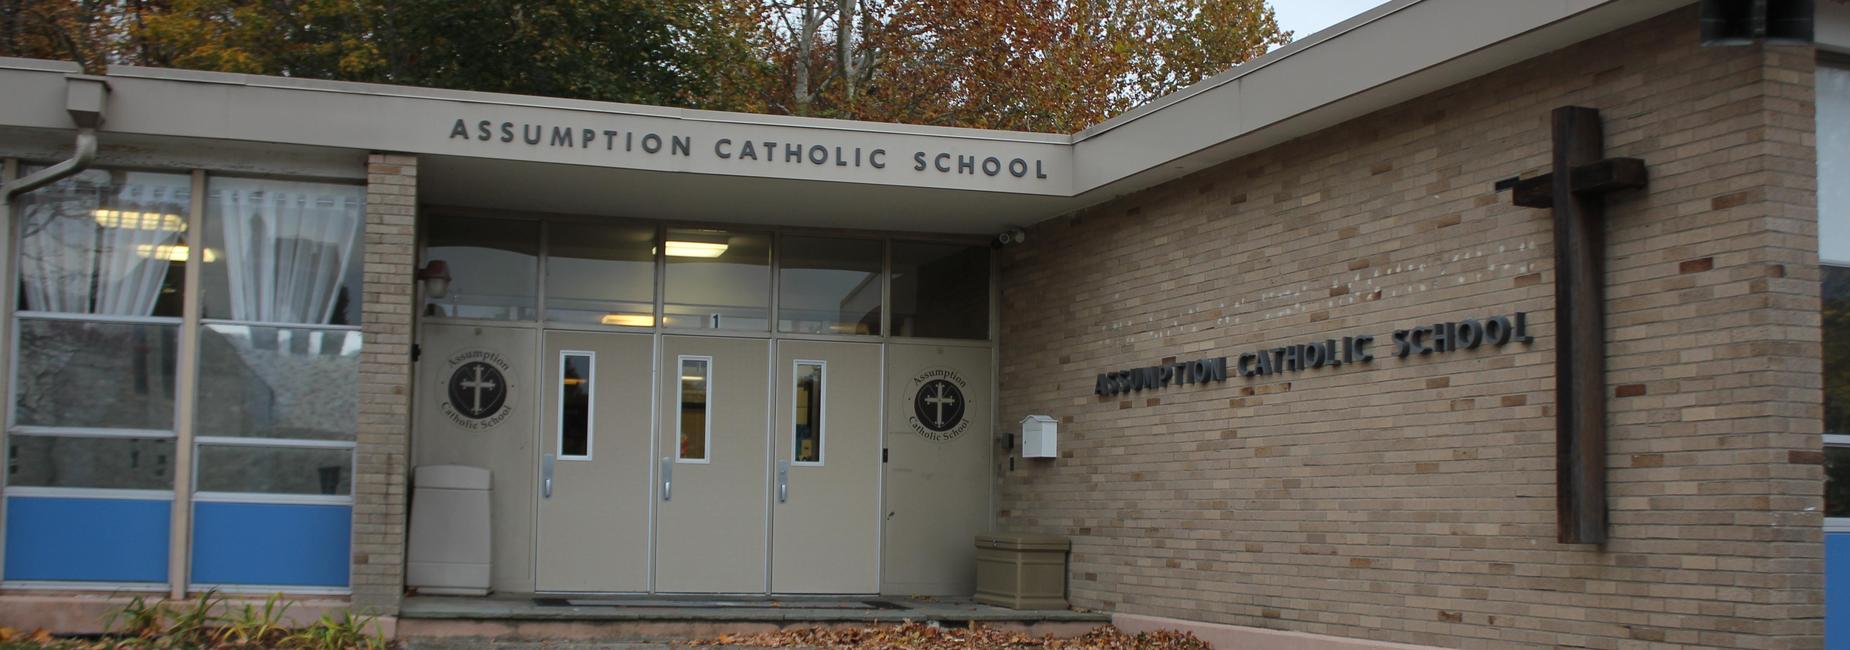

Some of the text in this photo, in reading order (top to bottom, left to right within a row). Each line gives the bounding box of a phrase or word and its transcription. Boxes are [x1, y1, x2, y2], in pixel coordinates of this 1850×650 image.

[449, 118, 1047, 180] ASSUMPTION CATHOLIC SCHOOL
[712, 313, 719, 329] 1
[448, 351, 510, 371] Assumption
[1094, 311, 1534, 397] ASSUMPTION CATHOLIC SCHOOL
[913, 369, 967, 389] Assumption
[441, 401, 512, 430] Catholic School
[909, 416, 969, 441] Catholic School
